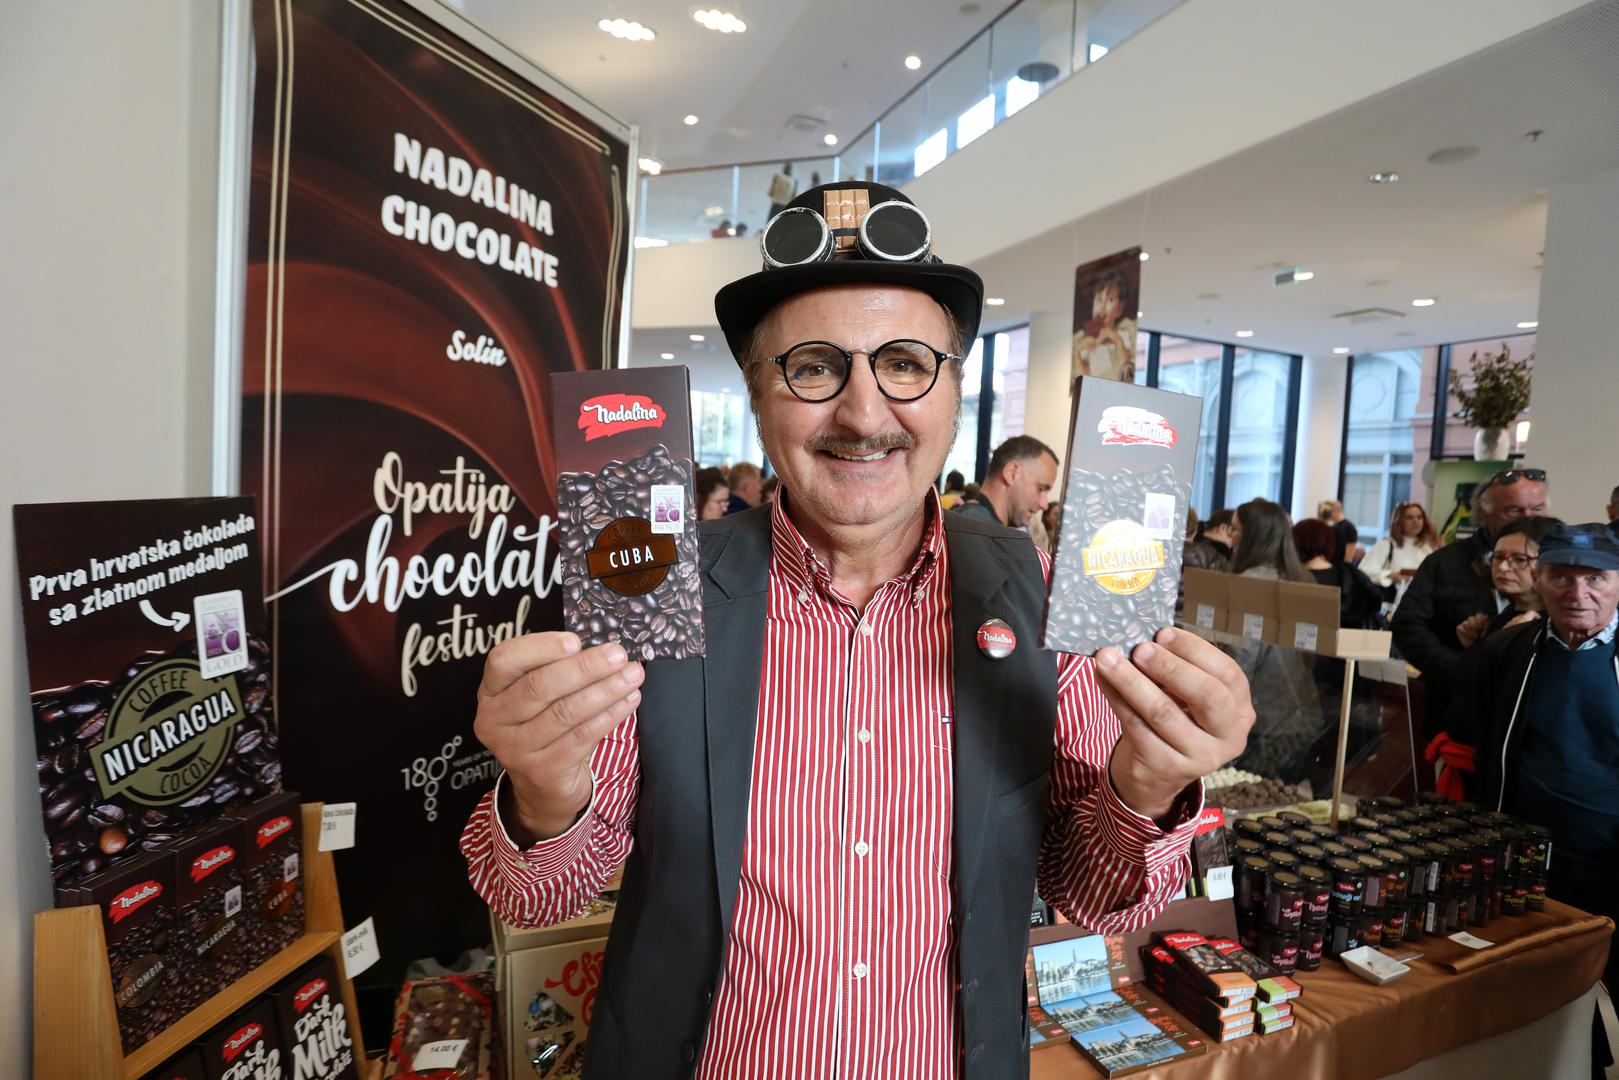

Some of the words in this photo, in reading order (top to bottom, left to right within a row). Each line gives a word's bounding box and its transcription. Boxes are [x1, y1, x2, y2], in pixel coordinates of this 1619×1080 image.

[393, 132, 554, 236] NADALINA
[381, 194, 559, 288] CHOCOLATE
[446, 329, 507, 367] Solin
[583, 402, 658, 424] Nadalina
[373, 451, 516, 539] Opatija
[29, 568, 87, 601] Prva
[90, 537, 182, 582] hrvatska
[183, 513, 256, 553] čokolada
[49, 600, 78, 626] sa
[81, 573, 167, 616] zlatnom
[168, 542, 250, 586] medaljom
[264, 514, 562, 613] chocolat
[609, 545, 654, 568] CUBA
[401, 594, 531, 698] festival
[128, 669, 189, 714] COFFEE
[102, 689, 236, 784] NICARAGUA
[159, 756, 213, 795] COCOA
[120, 960, 165, 1001] COLOMBIA
[294, 994, 333, 1043] Dark
[291, 1003, 353, 1080] Milk
